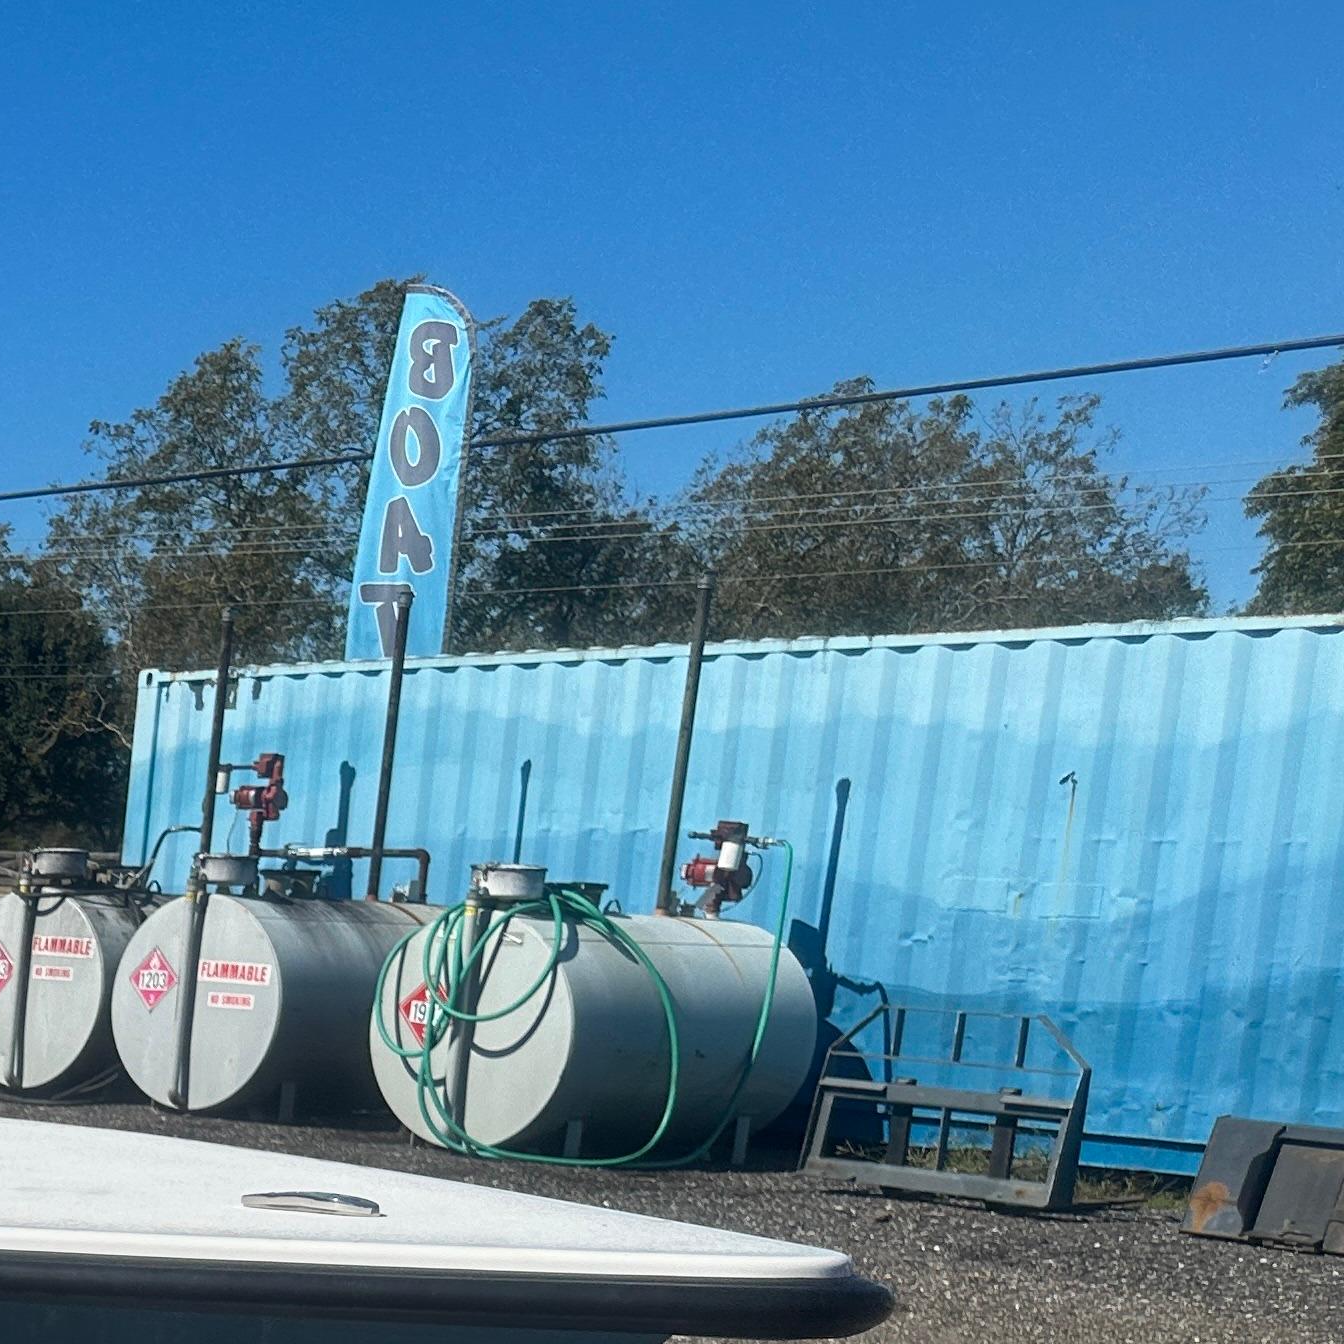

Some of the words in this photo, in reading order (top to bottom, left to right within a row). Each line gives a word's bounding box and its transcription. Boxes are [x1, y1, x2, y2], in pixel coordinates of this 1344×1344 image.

[33, 937, 92, 956] FLAMMABLE
[140, 971, 168, 988] 1203
[201, 961, 268, 983] FLAMMABLE
